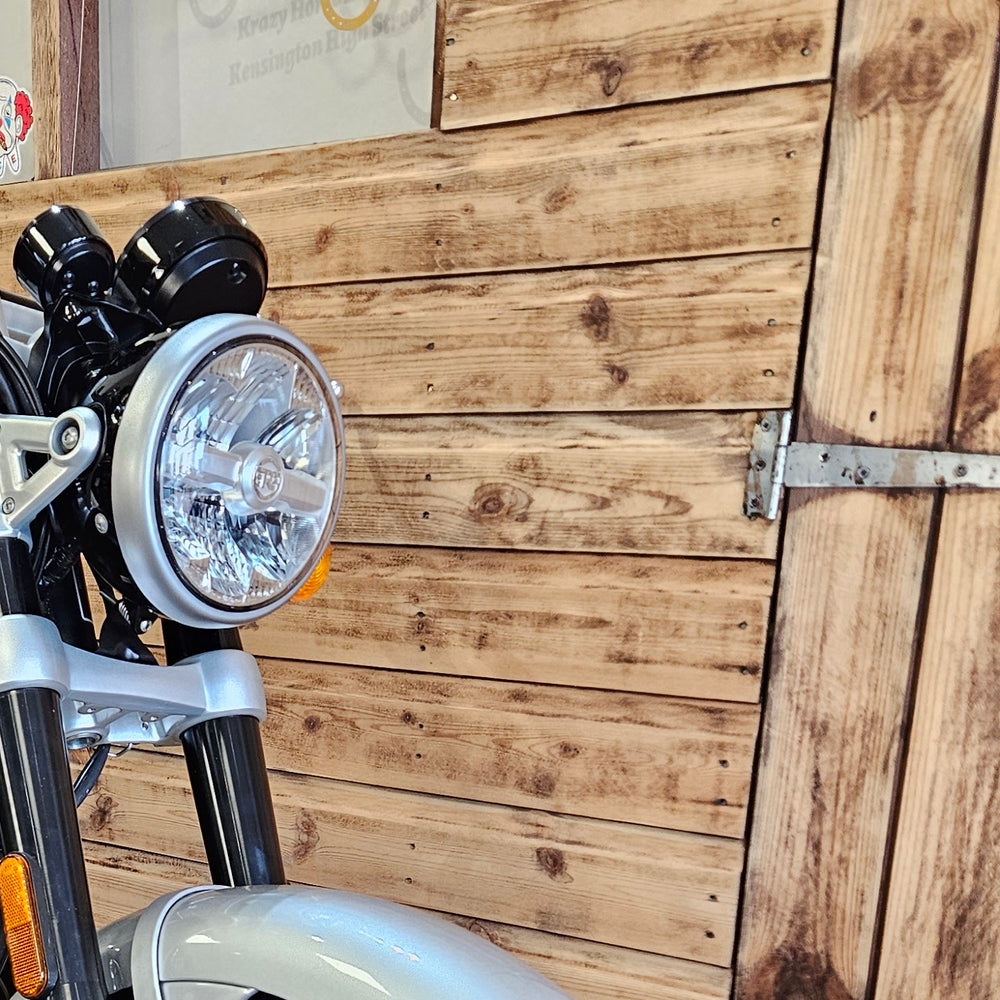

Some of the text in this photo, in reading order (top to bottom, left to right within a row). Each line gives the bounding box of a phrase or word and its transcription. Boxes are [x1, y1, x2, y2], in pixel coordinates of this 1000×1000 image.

[236, 8, 288, 40] Krazy
[227, 39, 322, 86] Kensington
[325, 27, 369, 53] High
